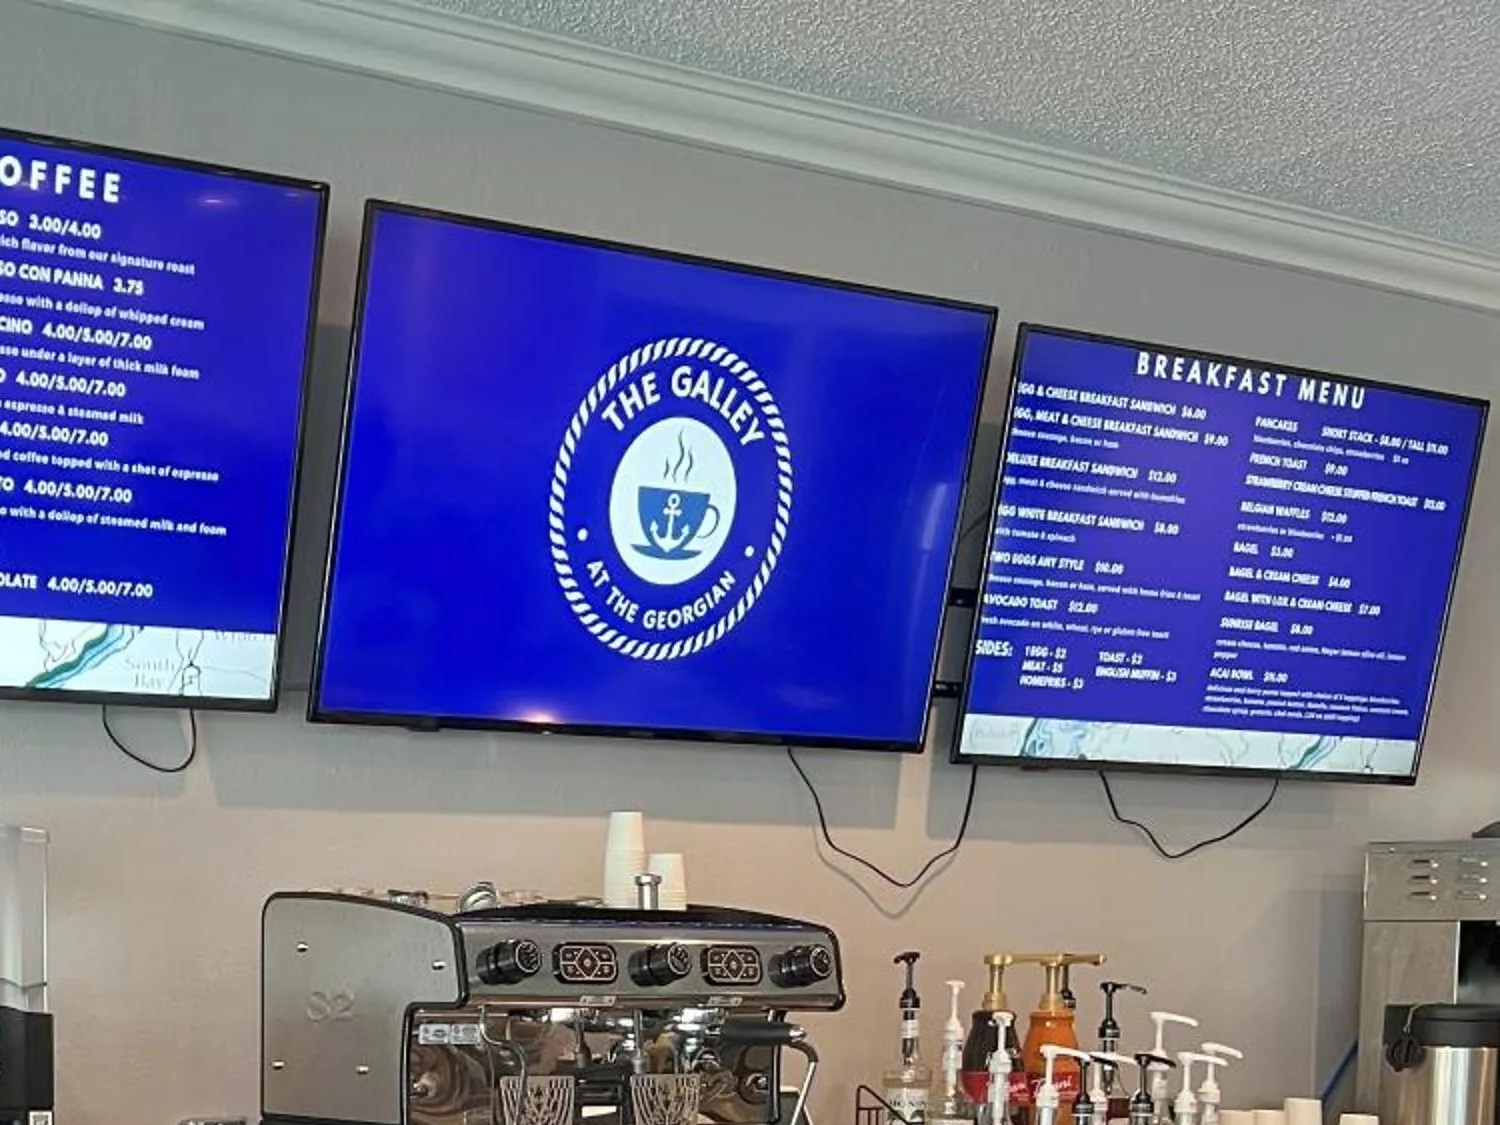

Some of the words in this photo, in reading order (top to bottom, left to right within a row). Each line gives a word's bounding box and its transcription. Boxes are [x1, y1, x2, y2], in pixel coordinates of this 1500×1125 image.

[29, 214, 101, 240] 3.00/4.00
[19, 264, 51, 283] CON
[54, 268, 104, 290] PANNA
[114, 278, 144, 296] 3.75
[42, 323, 152, 351] 4.00/5.00/7.00
[16, 371, 126, 397] 4.00/5.00/7.00
[1137, 352, 1287, 397] BREAKFAST
[1298, 378, 1365, 409] MENU
[601, 372, 661, 431] THE
[671, 365, 764, 446] GALLEY
[24, 480, 132, 503] 4.00/5.00/7.00
[48, 577, 153, 598] 4.00/5.00/7.00
[586, 560, 610, 587] AT
[605, 586, 640, 622] THE
[643, 571, 736, 630] GEORGIAN
